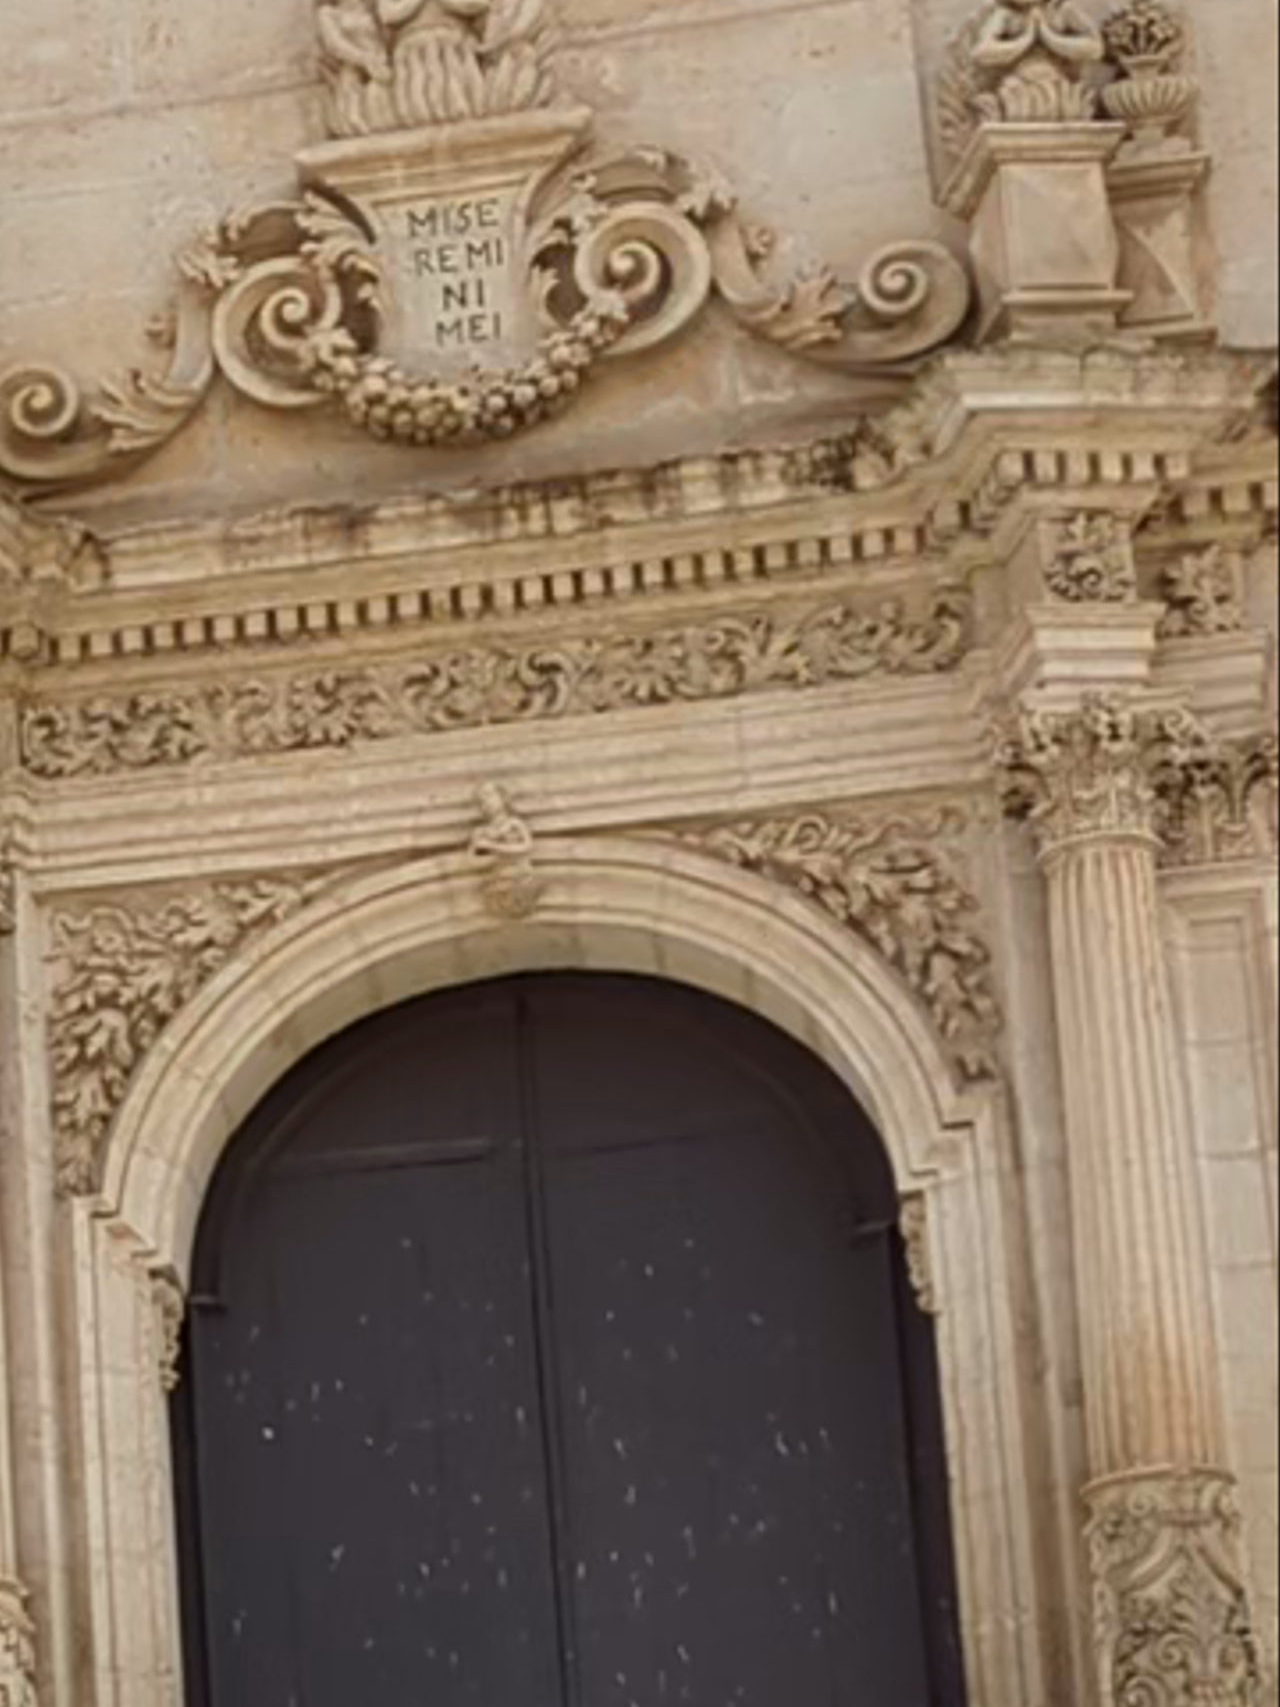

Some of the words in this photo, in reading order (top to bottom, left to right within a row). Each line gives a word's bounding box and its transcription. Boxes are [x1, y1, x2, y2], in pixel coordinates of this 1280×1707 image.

[406, 197, 499, 238] MISE
[413, 236, 504, 277] REMI
[442, 277, 485, 311] NI
[435, 310, 502, 347] MEI
